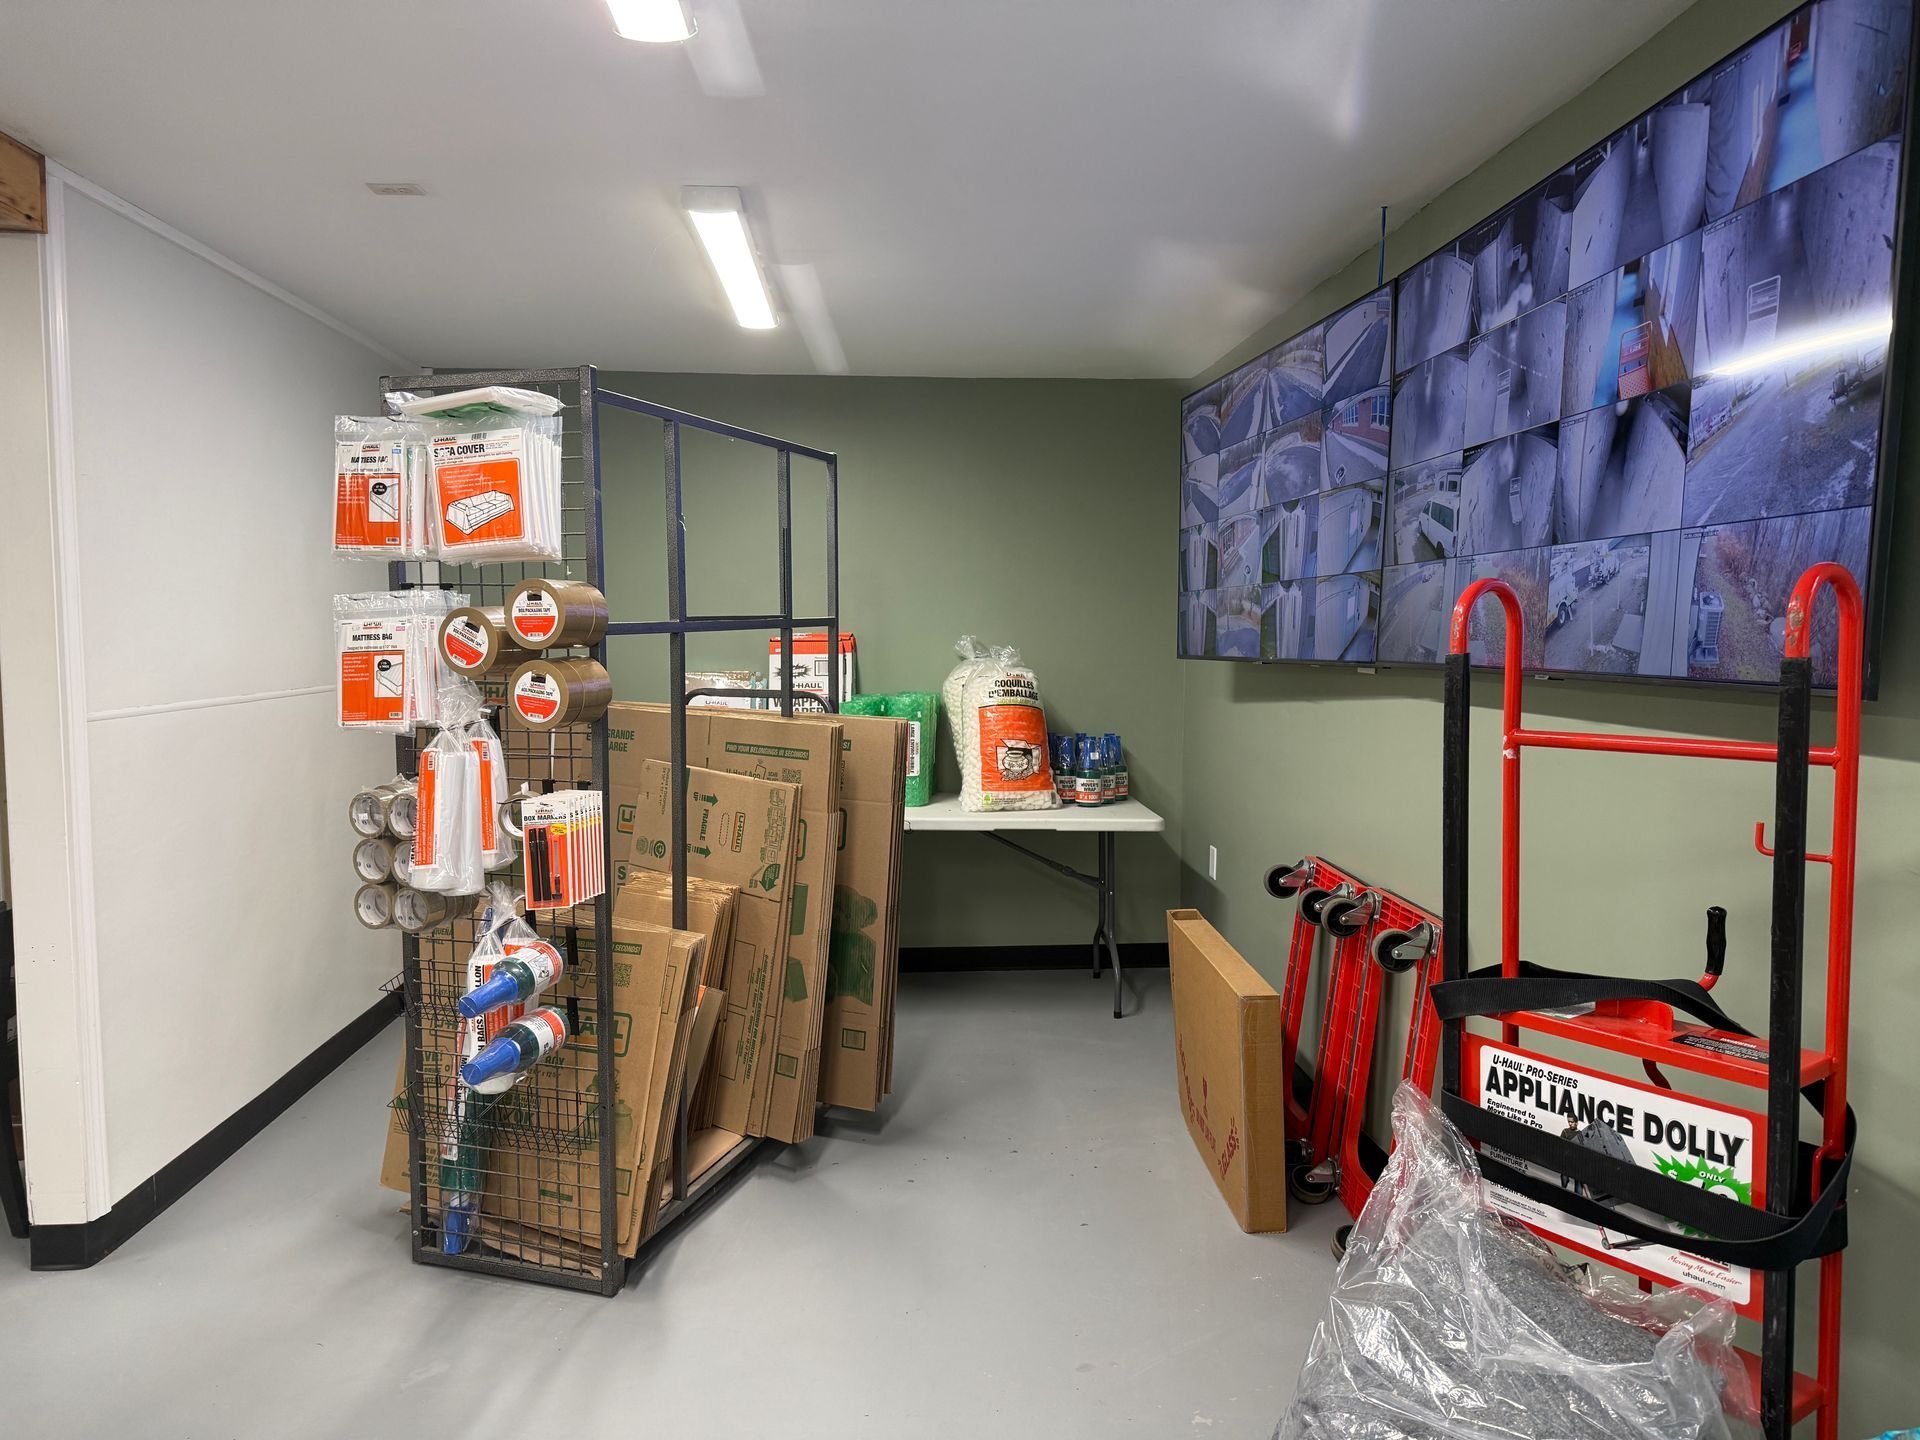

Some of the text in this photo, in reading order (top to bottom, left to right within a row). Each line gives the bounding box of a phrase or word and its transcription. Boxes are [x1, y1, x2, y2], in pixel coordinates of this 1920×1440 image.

[434, 446, 455, 458] SA
[457, 443, 485, 454] COVER
[994, 679, 1034, 690] COQUILLES
[988, 689, 1039, 701] D'EMBALLAGE
[609, 741, 628, 752] ARGE
[537, 813, 567, 821] MARS
[699, 808, 709, 841] FRAGILE
[735, 815, 744, 850] U-HAUL
[614, 944, 641, 954] SECONDS!
[1493, 1054, 1578, 1089] U-HAUL PRO-SERIES
[1485, 1066, 1745, 1169] APPLIANCE DOLLY
[1487, 1098, 1536, 1120] Engineered to
[1487, 1105, 1505, 1117] Move
[1507, 1111, 1522, 1122] Like
[1530, 1119, 1543, 1129] Pro
[1489, 1151, 1523, 1168] FURNITURE
[1699, 1171, 1725, 1184] ONLY
[1668, 1255, 1693, 1270] Moving
[1694, 1264, 1715, 1277] Made
[1682, 1271, 1726, 1290] uhaul.com
